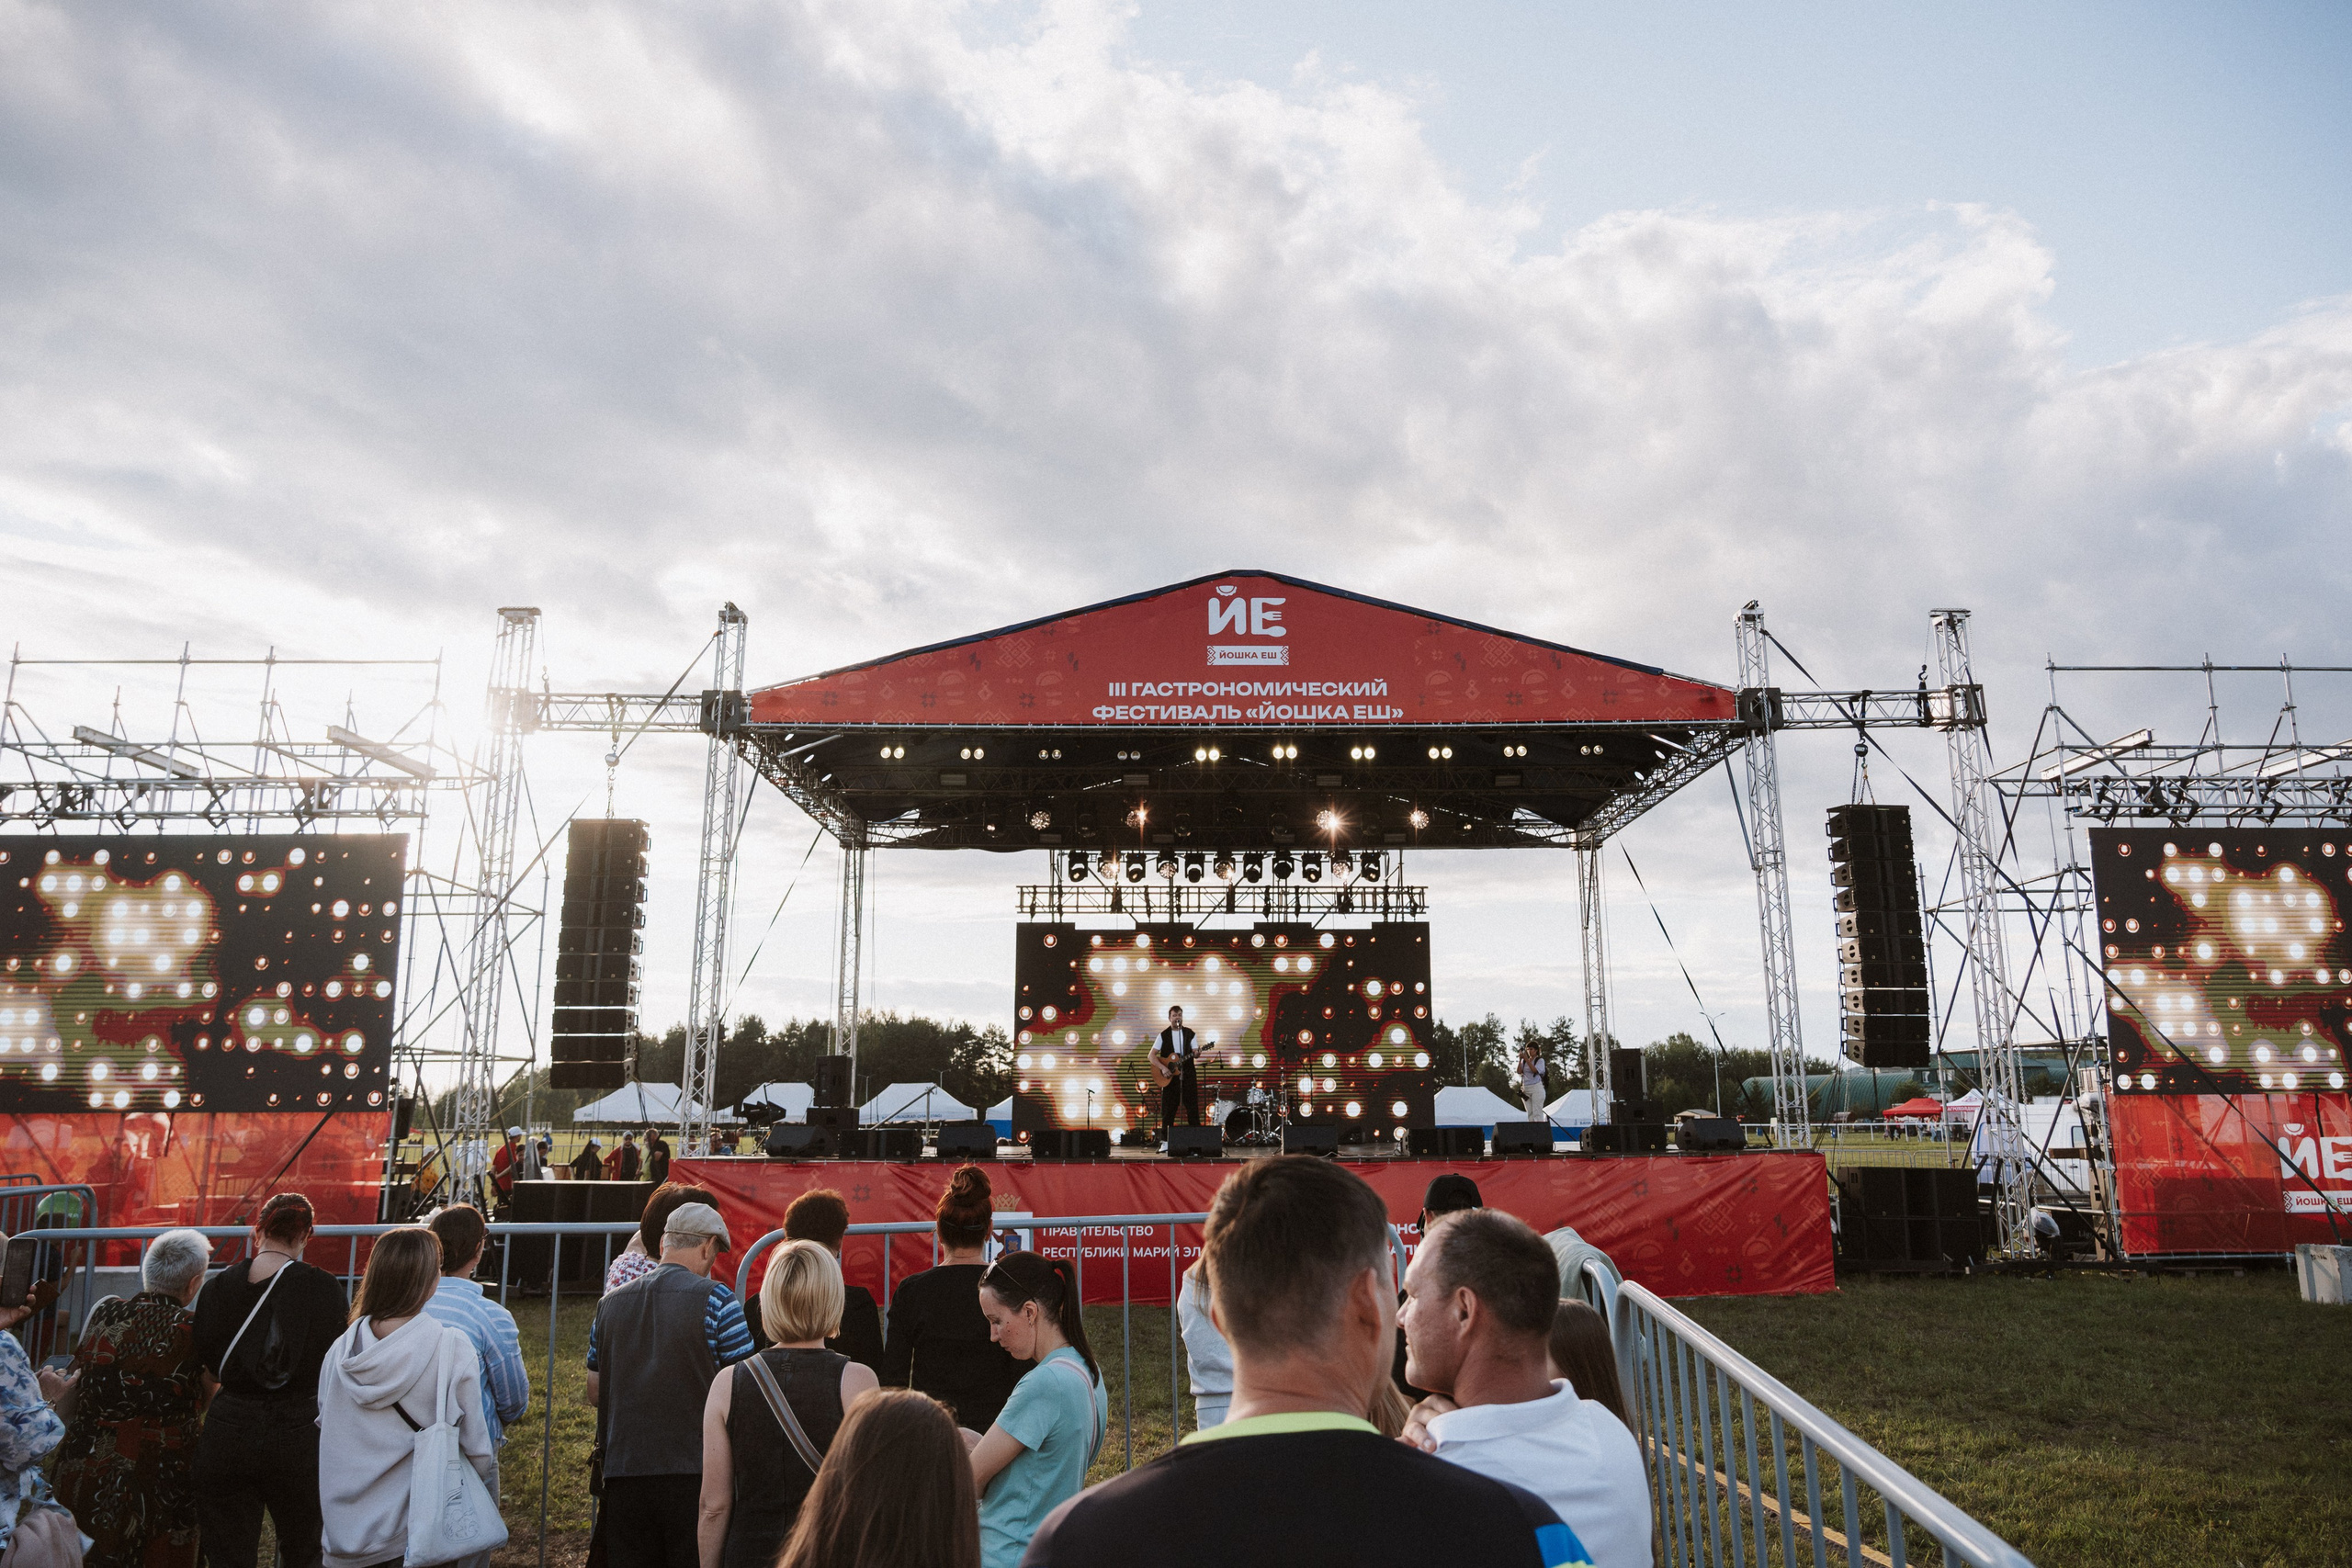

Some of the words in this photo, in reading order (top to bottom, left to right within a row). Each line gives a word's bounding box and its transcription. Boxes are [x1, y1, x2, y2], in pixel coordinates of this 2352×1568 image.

[1219, 649, 1259, 660] ЙОШКА
[1261, 651, 1277, 660] ЕШ
[1108, 682, 1126, 697] III
[1131, 678, 1388, 697] ГАСТРОНОМИЧЕСКИЙ
[1091, 705, 1242, 721] ФЕСТИВАЛЬ
[1245, 700, 1350, 720] «ЙОШКА
[1353, 705, 1405, 720] ЕШ»
[2295, 1196, 2328, 1206] ЙОШК
[1182, 1246, 1202, 1258] ЭЛ
